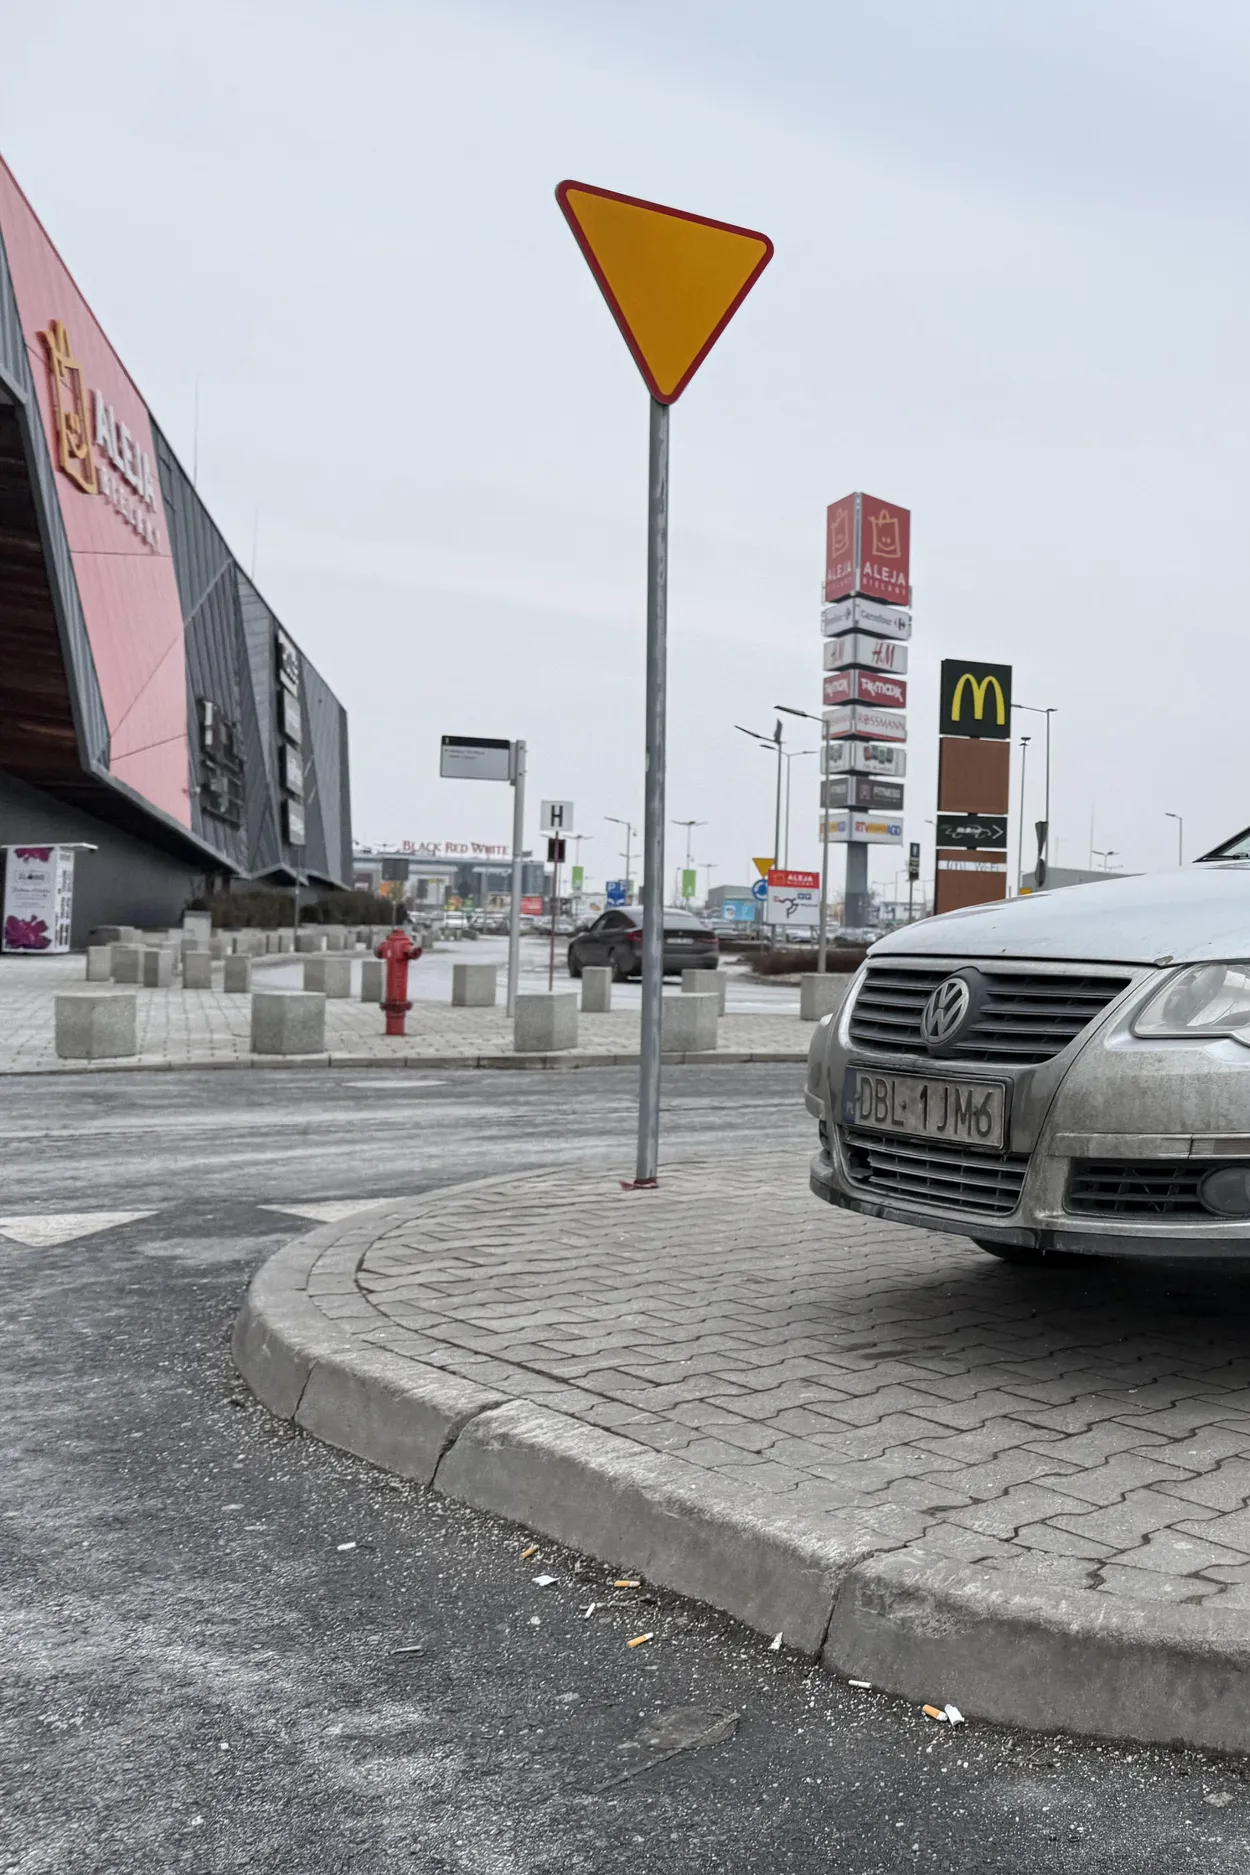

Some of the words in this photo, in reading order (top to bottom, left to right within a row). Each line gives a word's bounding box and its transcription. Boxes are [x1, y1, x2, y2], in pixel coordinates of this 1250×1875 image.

[96, 388, 157, 513] ALEJA
[863, 561, 906, 587] ALEJA
[550, 804, 563, 827] H
[445, 840, 469, 854] RED
[787, 873, 813, 882] ALEJA
[860, 1076, 904, 1126] DBL
[919, 1084, 993, 1138] 1JM6
